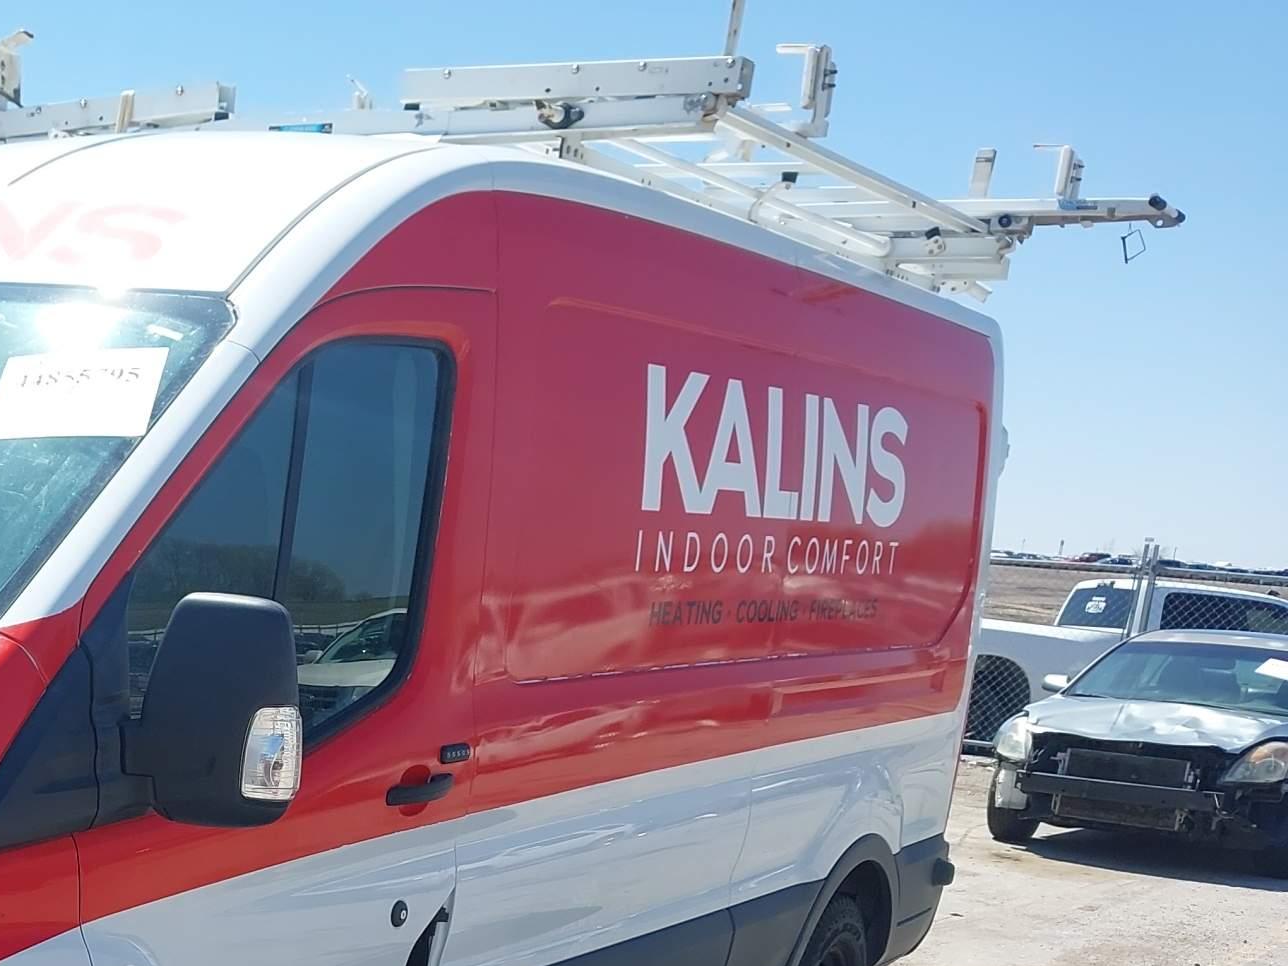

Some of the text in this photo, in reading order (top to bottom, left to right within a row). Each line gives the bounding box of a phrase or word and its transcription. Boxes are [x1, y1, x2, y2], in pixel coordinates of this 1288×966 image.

[641, 363, 909, 527] KALINS
[634, 529, 899, 575] INDOOR COMFORT
[649, 601, 723, 627] HEATING
[736, 599, 798, 624] COOLING
